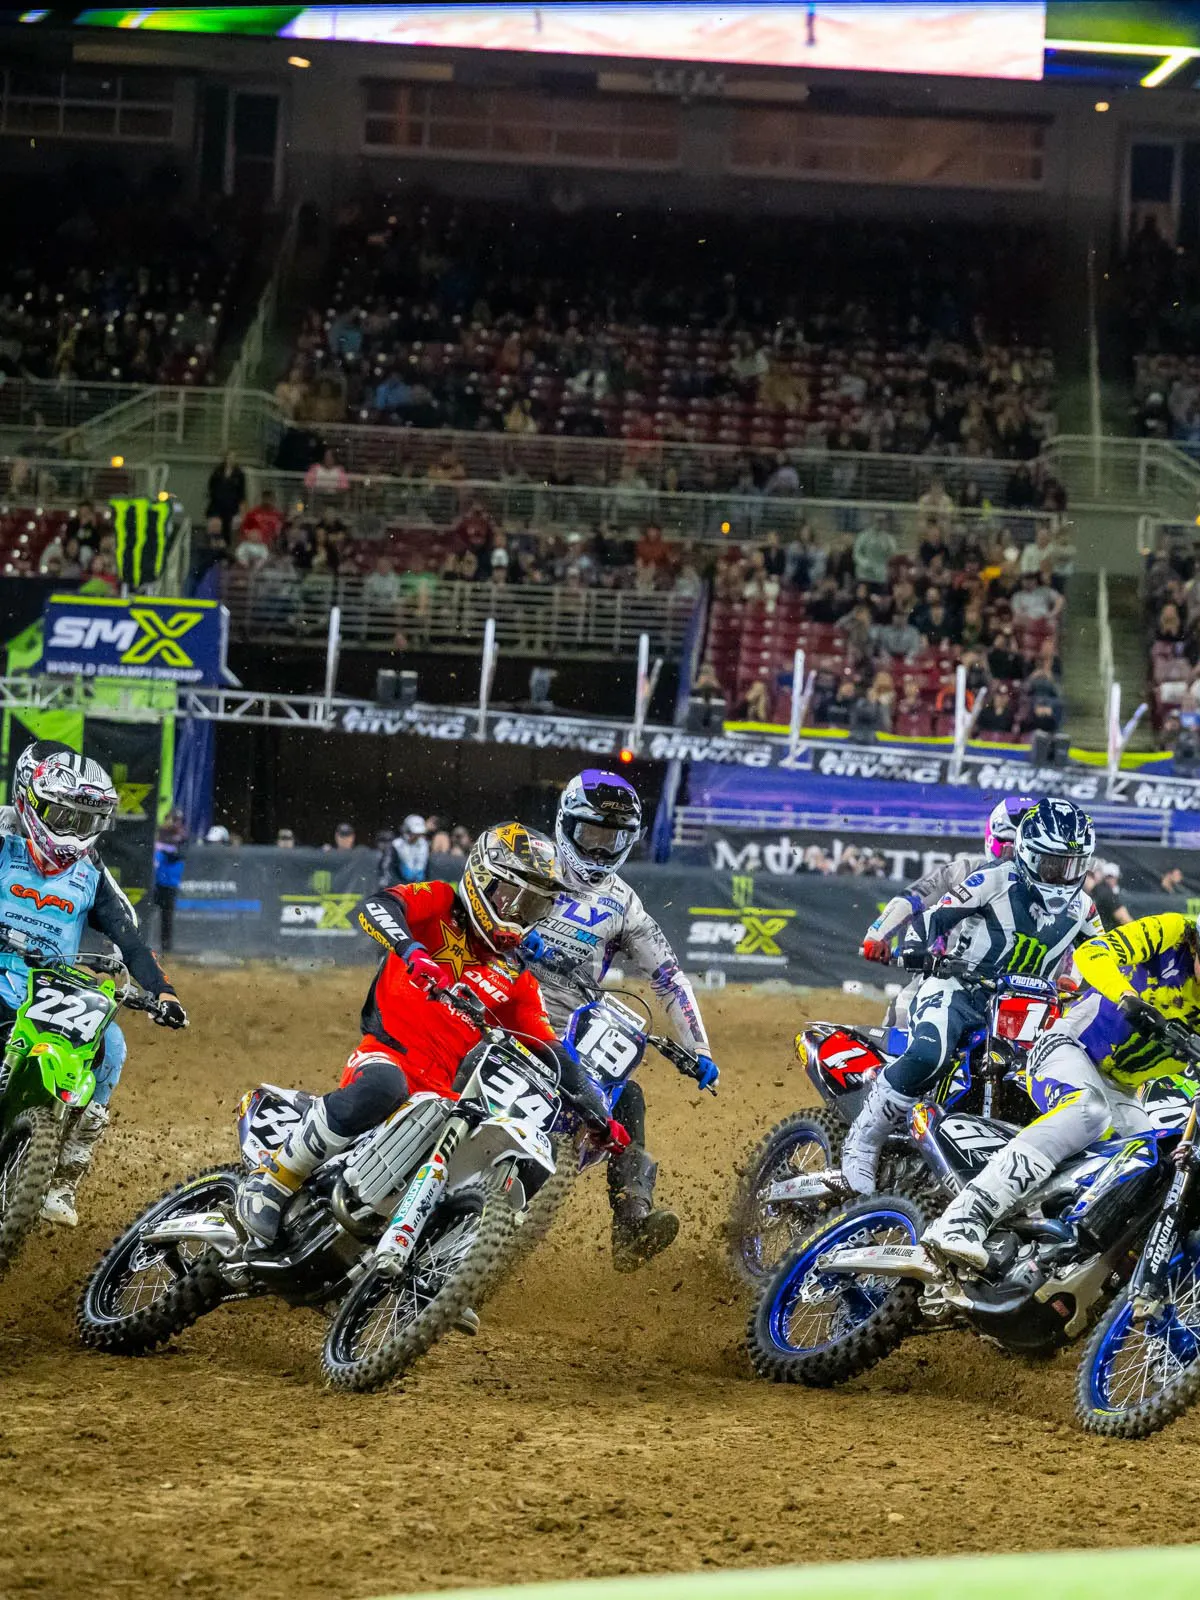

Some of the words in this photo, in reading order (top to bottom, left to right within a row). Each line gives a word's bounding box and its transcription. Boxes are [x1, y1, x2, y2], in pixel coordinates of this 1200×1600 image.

[48, 608, 204, 667] SMX
[46, 661, 96, 676] WORLD
[5, 911, 63, 935] GRINDSTONE
[464, 871, 494, 933] ROCKSTAR
[541, 933, 591, 957] PAULSON
[687, 916, 788, 956] SMX
[25, 987, 106, 1043] 224
[575, 1018, 638, 1078] 19
[482, 1065, 554, 1128] 34
[882, 1247, 915, 1258] YAMALUBE
[1152, 1215, 1174, 1274] DUNLOP
